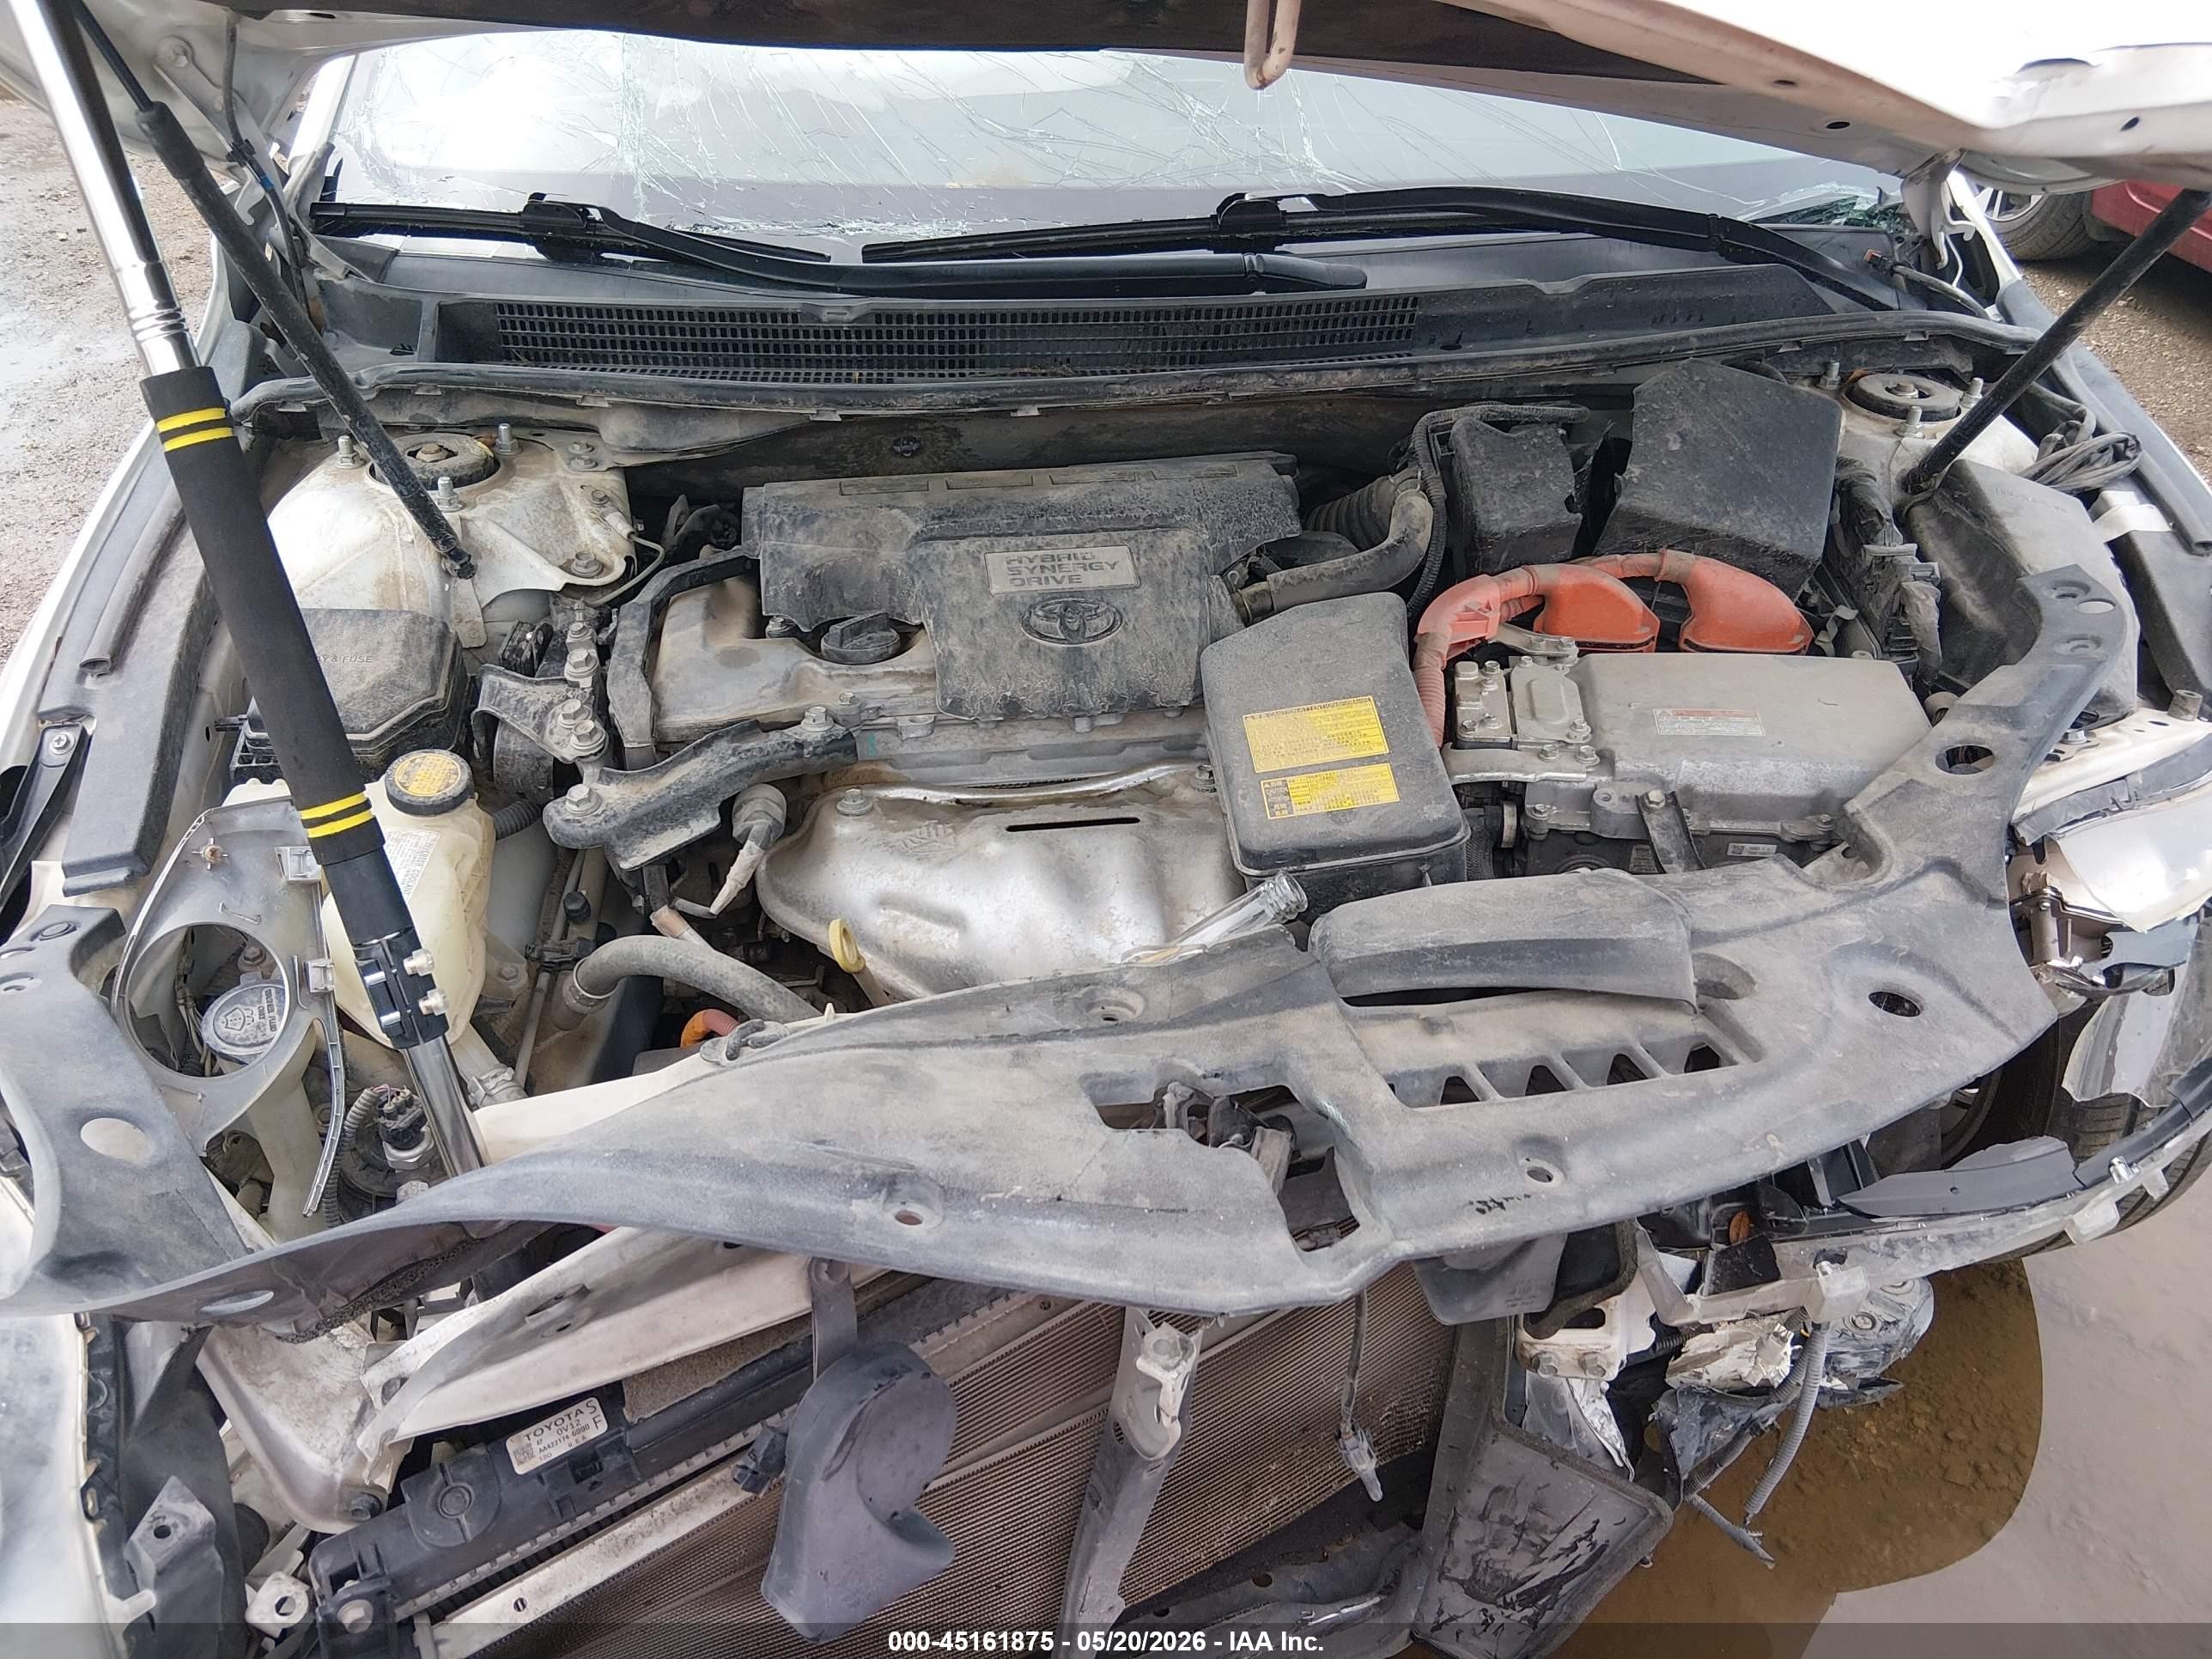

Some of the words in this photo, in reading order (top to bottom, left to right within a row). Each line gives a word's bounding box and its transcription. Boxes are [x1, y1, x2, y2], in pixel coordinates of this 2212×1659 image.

[1006, 552, 1096, 565] HYBRID
[1006, 561, 1120, 576] SYNERGY
[1009, 574, 1083, 587] DRIVE
[523, 1408, 585, 1442] TOYOTA
